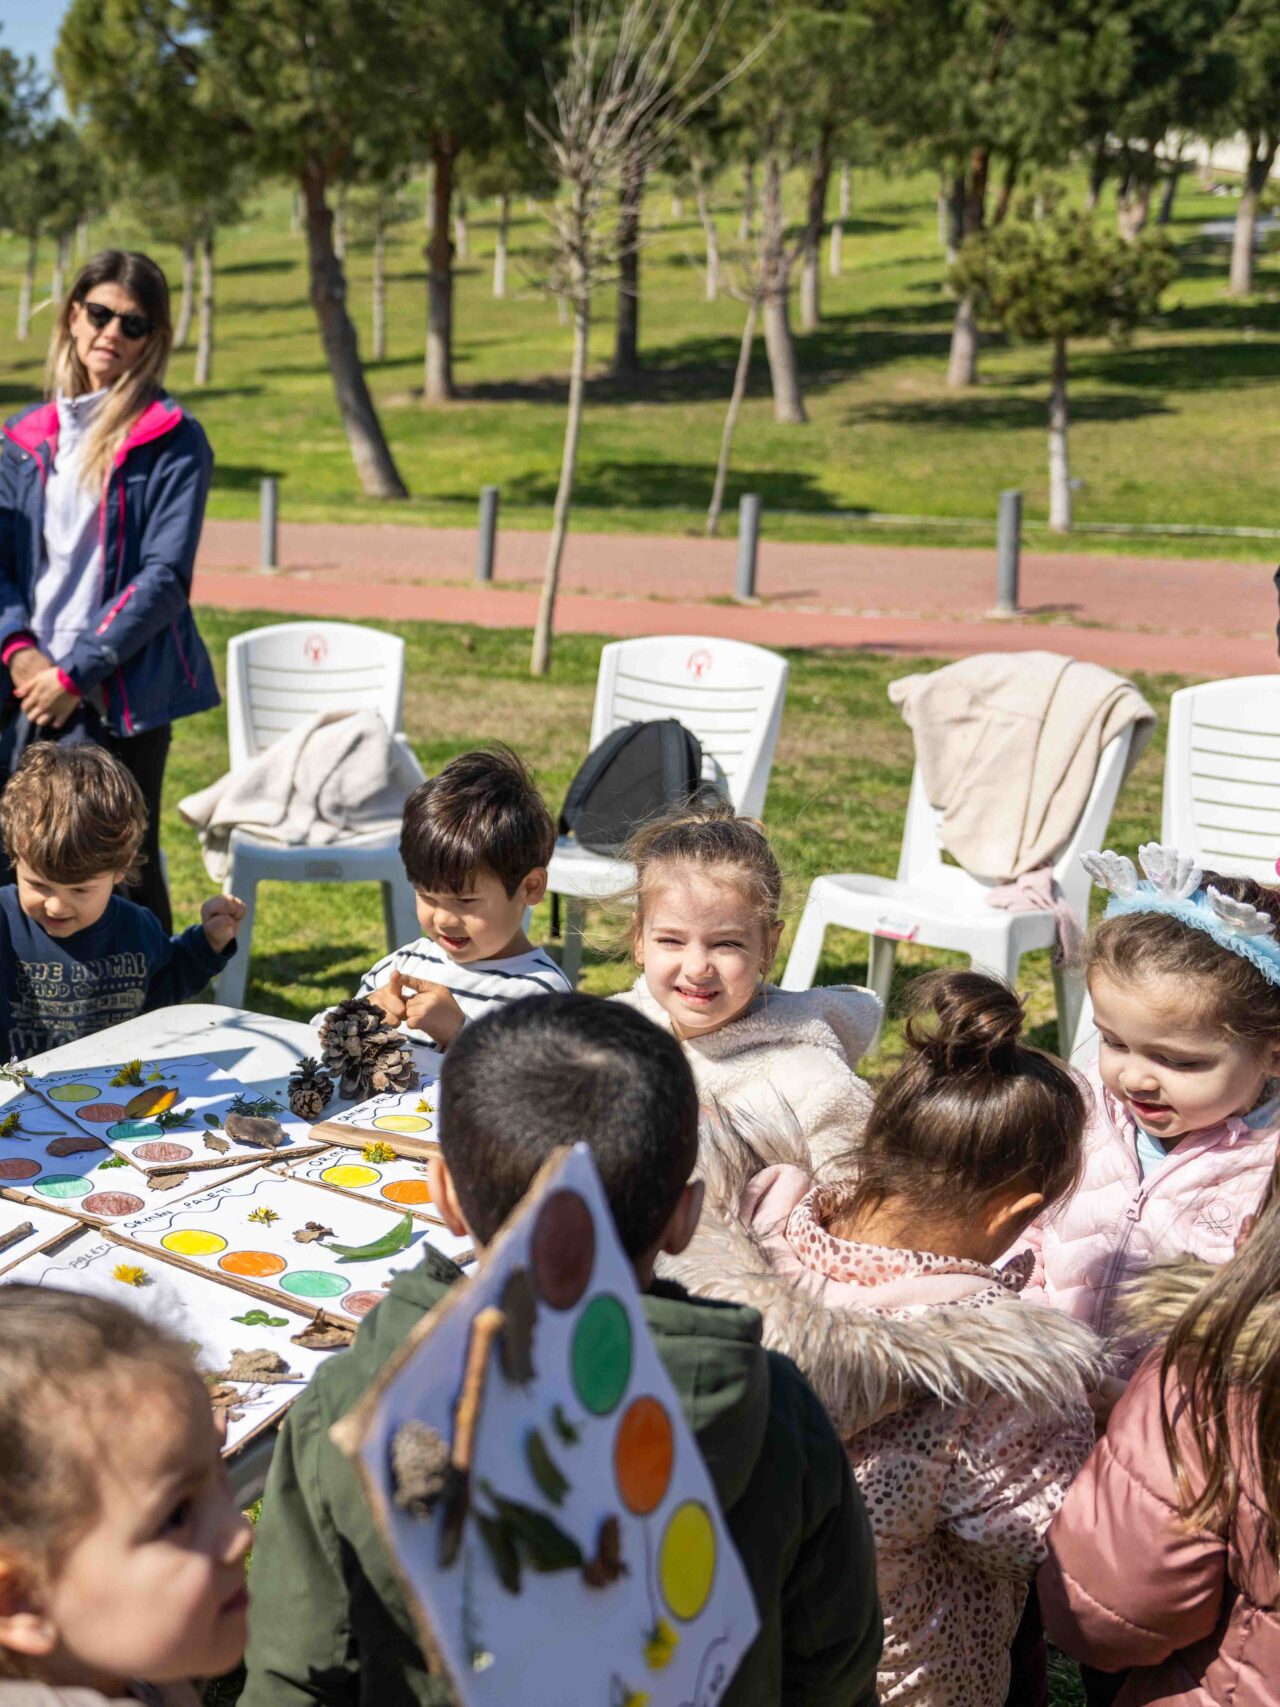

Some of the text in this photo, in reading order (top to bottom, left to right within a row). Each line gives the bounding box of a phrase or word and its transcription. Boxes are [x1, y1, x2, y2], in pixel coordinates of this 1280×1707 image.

[17, 952, 147, 982] THE ANIMAL
[308, 1146, 350, 1166] ORMA
[123, 1210, 173, 1229] ORMAN
